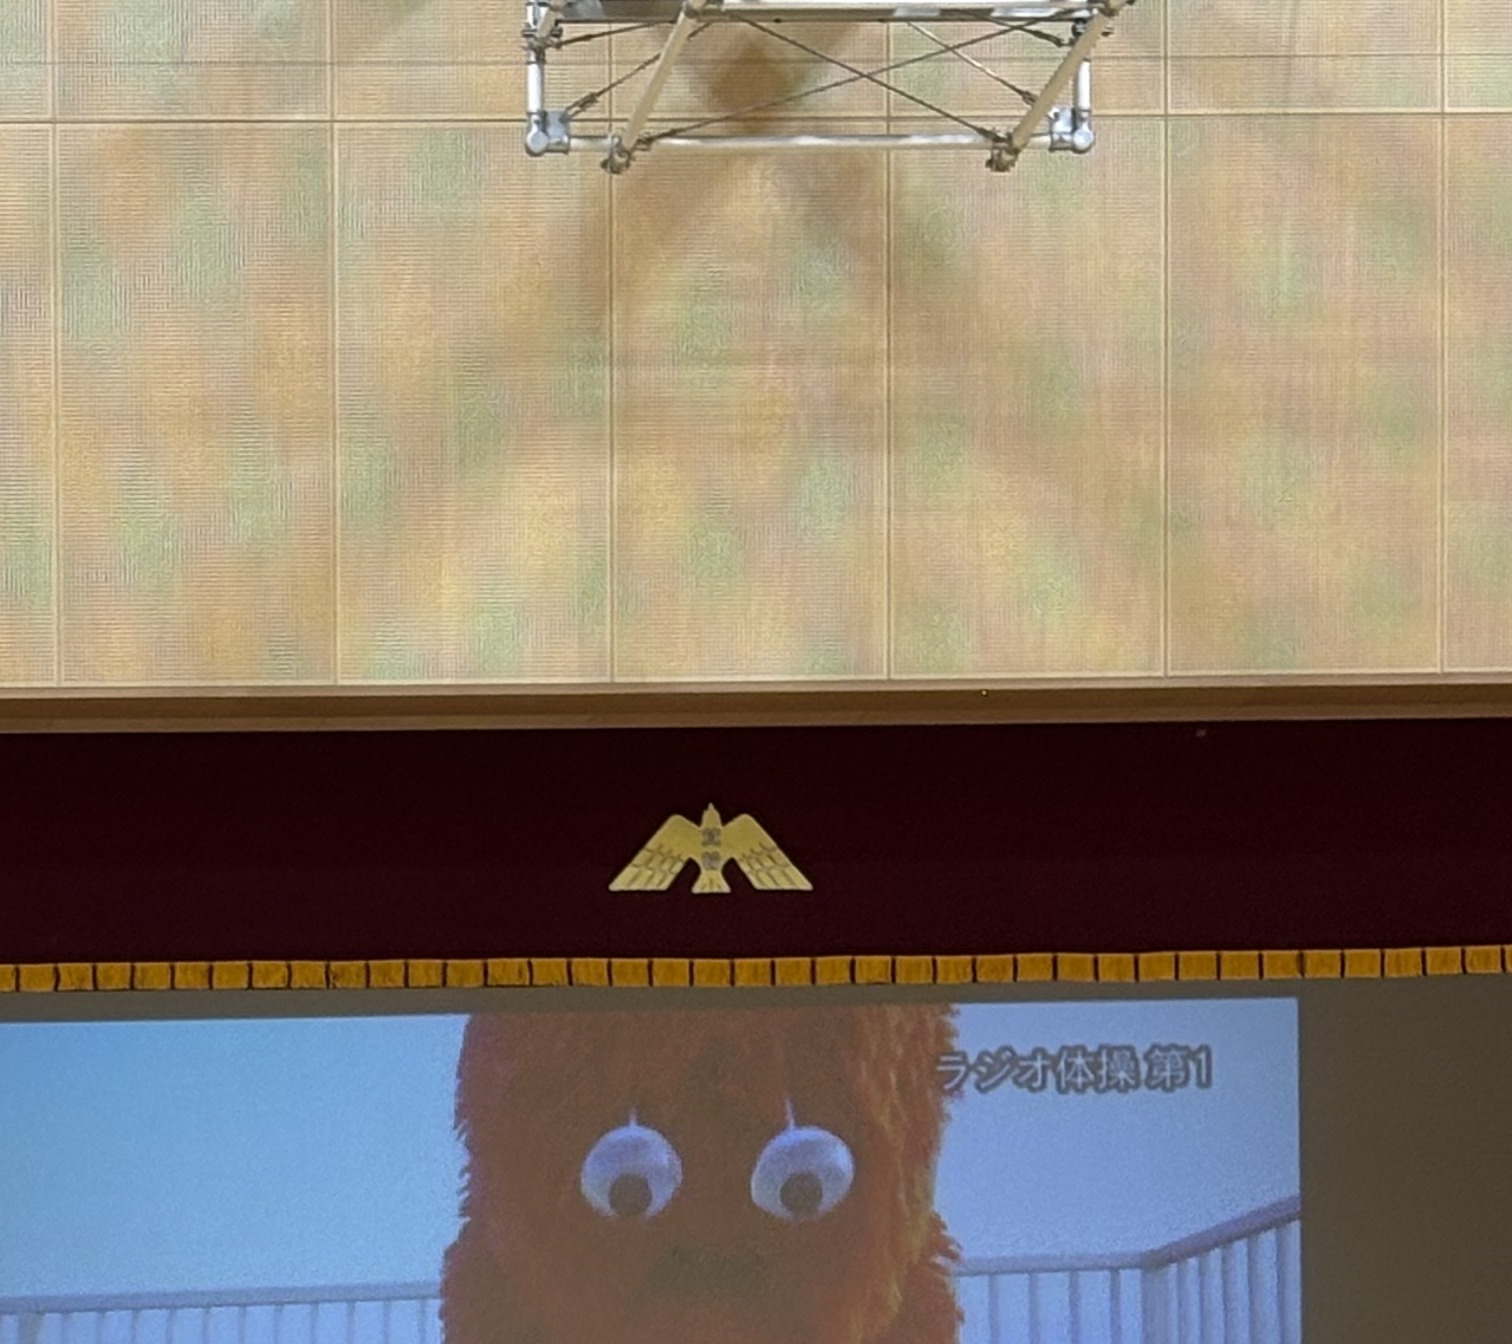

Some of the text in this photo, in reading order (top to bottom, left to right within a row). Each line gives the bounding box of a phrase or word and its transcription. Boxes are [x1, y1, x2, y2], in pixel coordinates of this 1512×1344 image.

[937, 1043, 1211, 1090] ラジオ体操 第1
